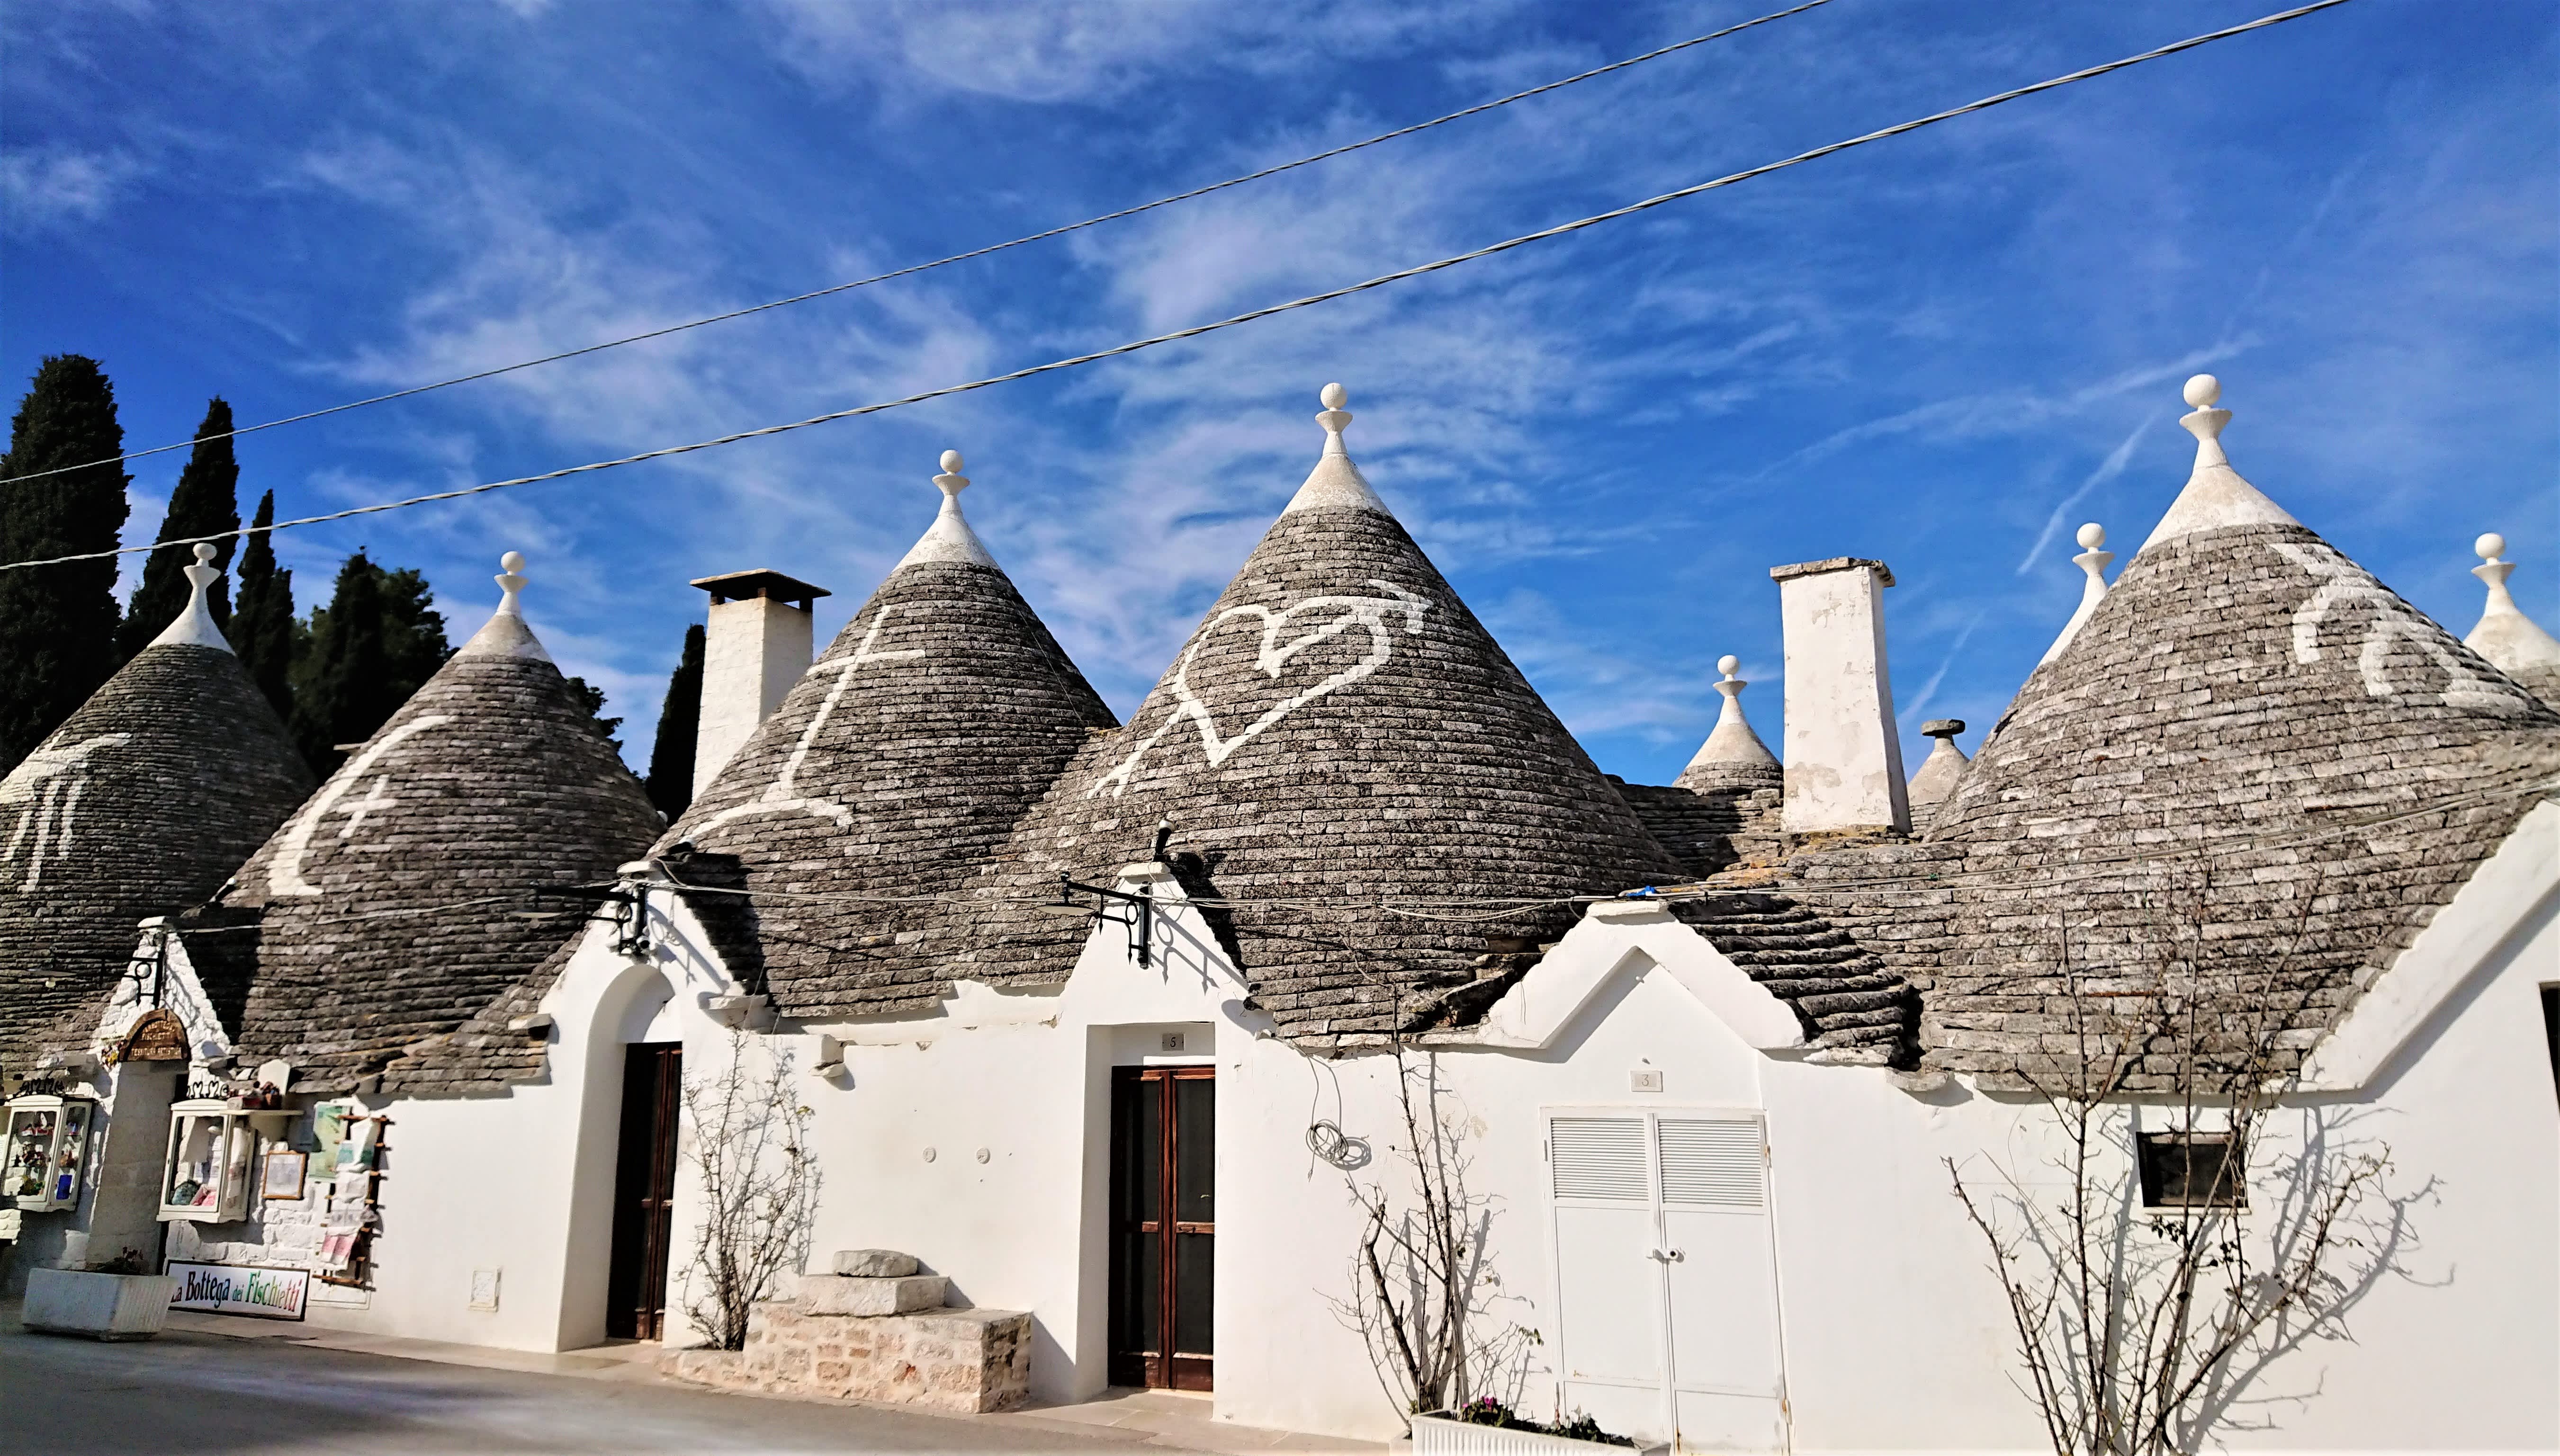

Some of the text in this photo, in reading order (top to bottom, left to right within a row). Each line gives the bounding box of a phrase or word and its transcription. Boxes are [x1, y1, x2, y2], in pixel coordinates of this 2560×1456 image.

[1170, 1037, 1176, 1047] 5
[1642, 1074, 1649, 1086] 3
[185, 1270, 231, 1309] Bottega
[233, 1284, 244, 1302] dei
[245, 1270, 303, 1312] Fischietti
